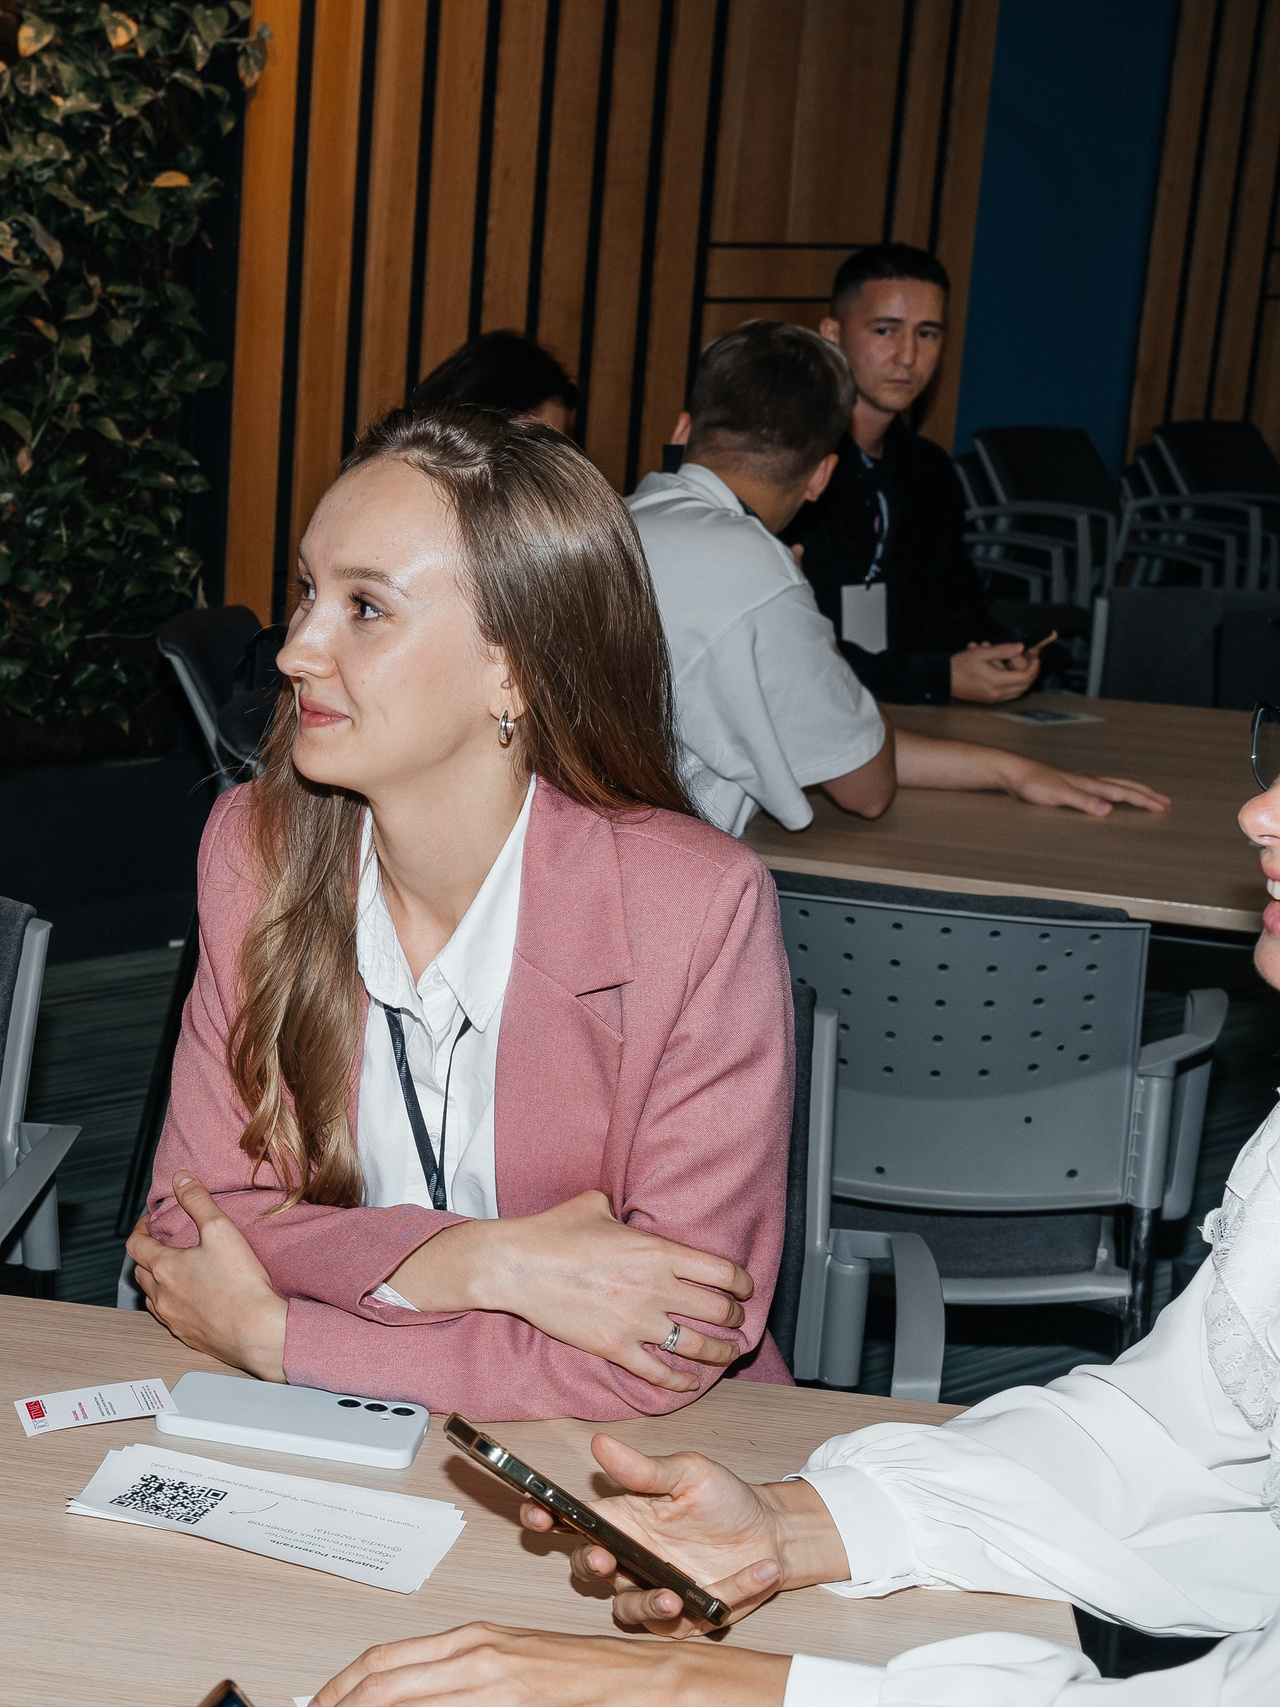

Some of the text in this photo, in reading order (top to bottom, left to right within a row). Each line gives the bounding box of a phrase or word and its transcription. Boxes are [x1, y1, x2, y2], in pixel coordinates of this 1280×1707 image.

[301, 1498, 348, 1512] вакансиями
[355, 1511, 378, 1519] канал
[387, 1518, 420, 1529] Соцсети
[247, 1520, 396, 1559] образовательных проектов
[263, 1531, 390, 1565] Методолог, маркетолог
[313, 1527, 402, 1552] @nadia_rozental
[270, 1539, 384, 1571] Надежда Розенталь
